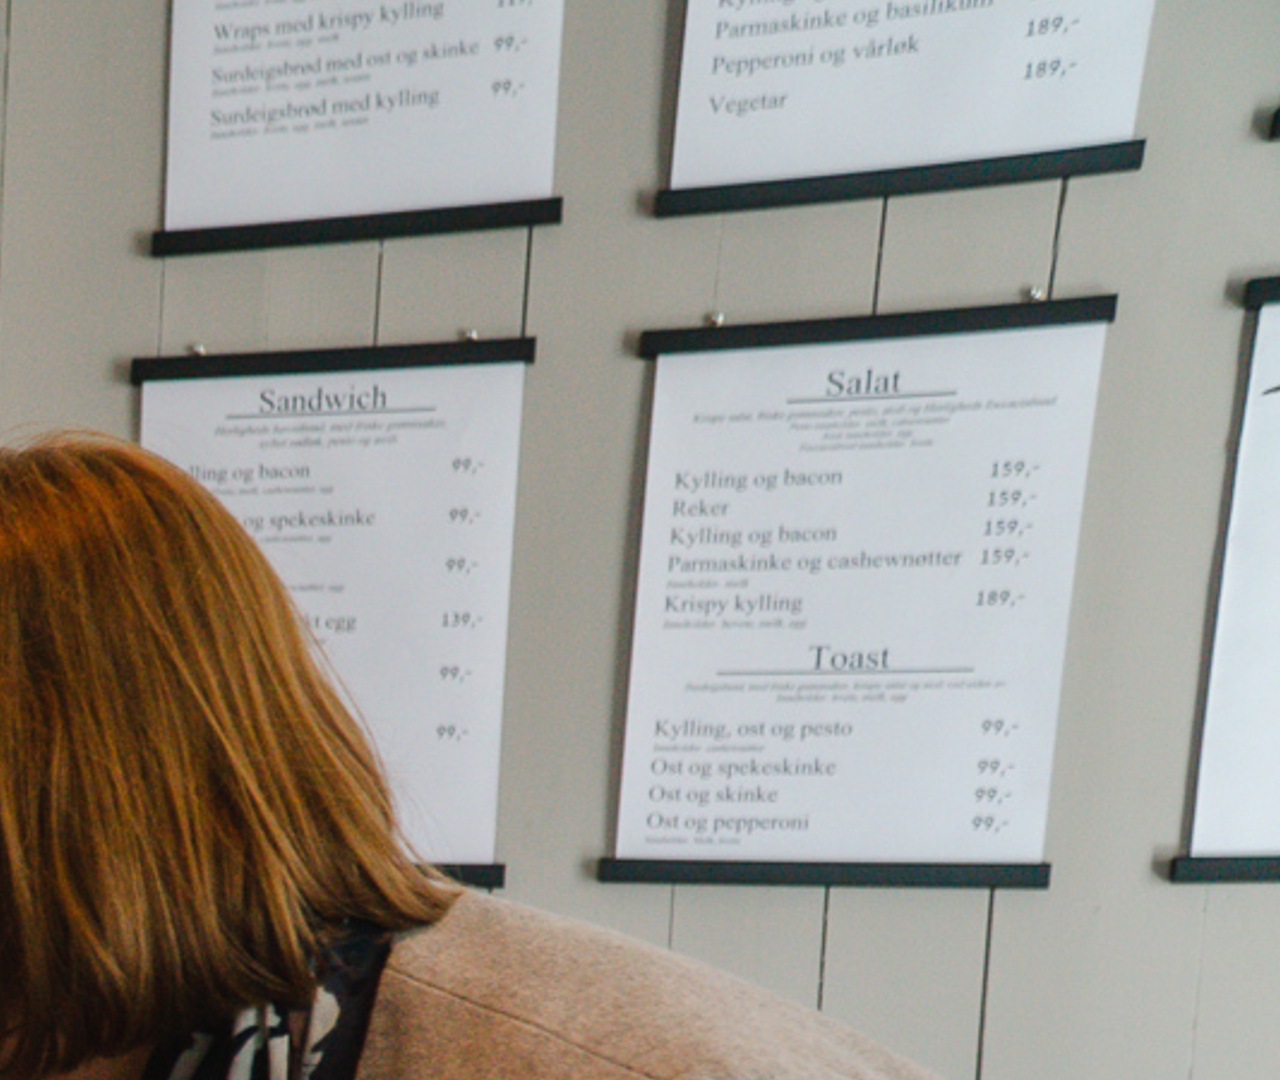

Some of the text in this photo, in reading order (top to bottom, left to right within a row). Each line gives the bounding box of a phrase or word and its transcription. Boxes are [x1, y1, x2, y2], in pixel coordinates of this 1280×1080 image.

[214, 2, 444, 42] Wraps med krispy kylling
[715, 10, 847, 39] Parmaskinke
[853, 9, 878, 28] og
[1025, 16, 1080, 38] 189,-
[326, 53, 362, 71] med
[366, 52, 391, 67] ost
[397, 51, 417, 66] og
[423, 40, 479, 59] skinke
[712, 48, 814, 77] Pepperoni
[819, 48, 846, 68] og
[1024, 59, 1078, 80] 189,-
[332, 93, 370, 114] med
[376, 89, 439, 112] kylling
[709, 94, 787, 117] Vegetar
[826, 368, 901, 397] Salat
[259, 385, 387, 414] Sandwich
[189, 463, 310, 484] lling og bacon
[991, 460, 1040, 478] 159,-
[675, 468, 843, 493] Kylling og bacon
[672, 498, 730, 517] Reker
[987, 490, 1037, 508] 159,-
[270, 510, 376, 532] spekeskinke
[670, 525, 837, 549] Kylling og bacon
[668, 554, 791, 573] Parmaskinke
[797, 556, 821, 574] og
[665, 594, 803, 616] Krispy kylling
[324, 616, 357, 634] egg
[808, 645, 889, 671] Toast
[654, 719, 853, 740] Kylling, ost og pesto
[650, 758, 837, 779] Ost og spekeskinke
[648, 785, 779, 807] Ost og skinke
[646, 812, 809, 835] Ost og pepperoni
